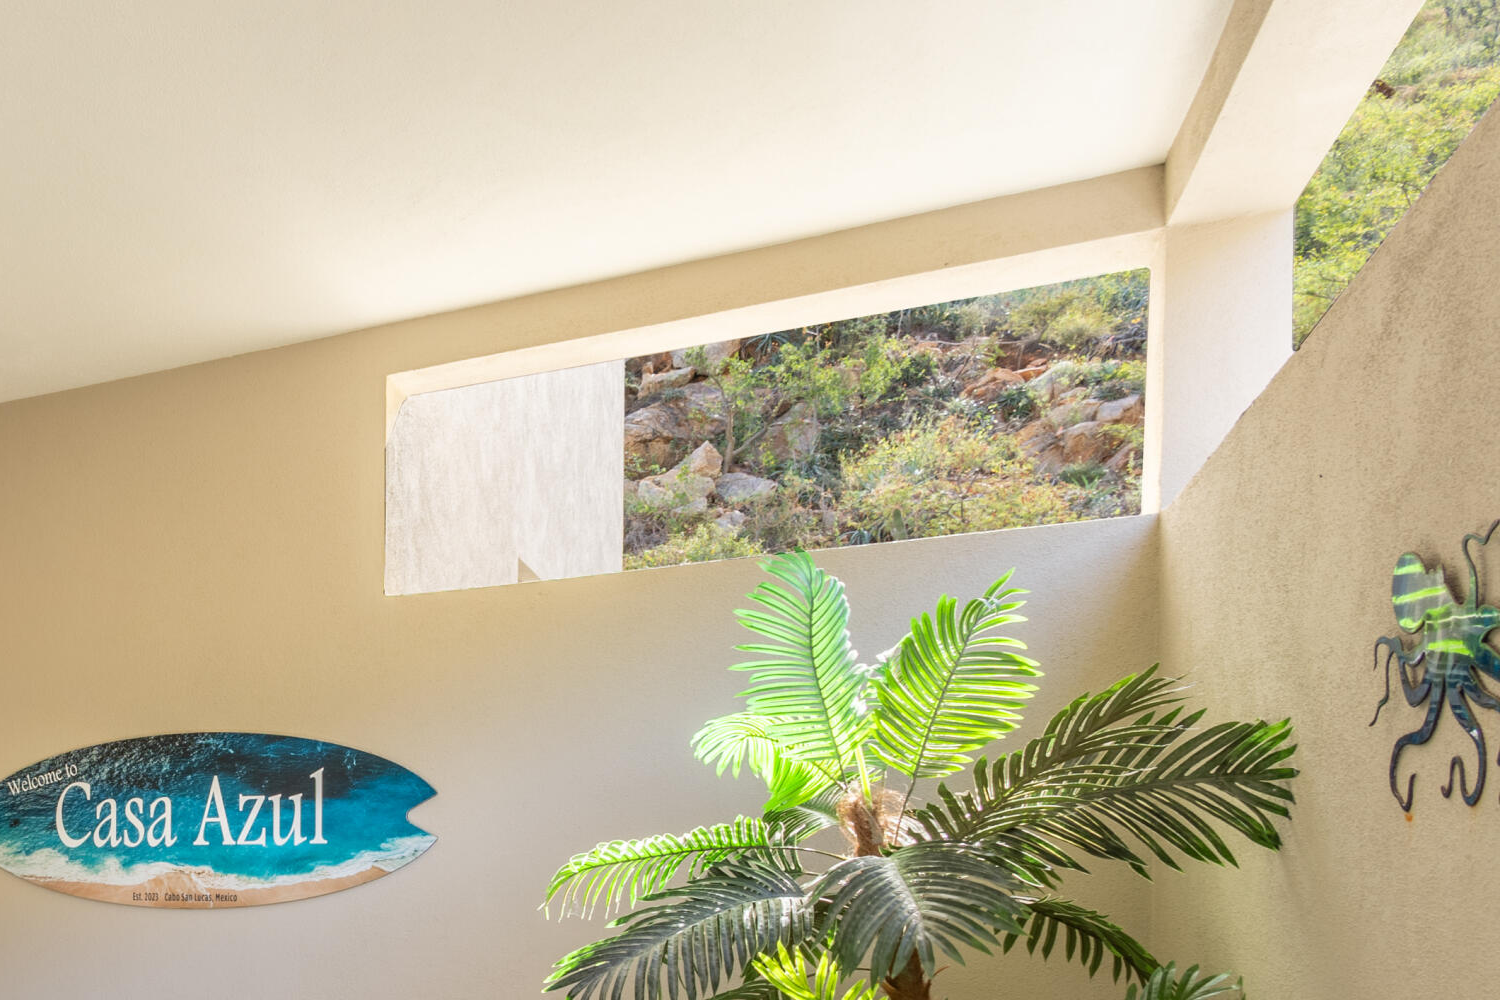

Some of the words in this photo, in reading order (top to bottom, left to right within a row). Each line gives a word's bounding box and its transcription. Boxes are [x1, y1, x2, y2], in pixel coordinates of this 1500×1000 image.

[7, 769, 62, 797] Welcome
[64, 763, 78, 781] to
[55, 781, 178, 848] Casa
[193, 767, 328, 847] Azul
[132, 892, 143, 901] Est.
[144, 892, 159, 901] 2023
[164, 892, 181, 902] Cabo
[181, 892, 193, 902] San
[194, 892, 214, 903] Lucas,
[215, 892, 238, 902] Mexico
